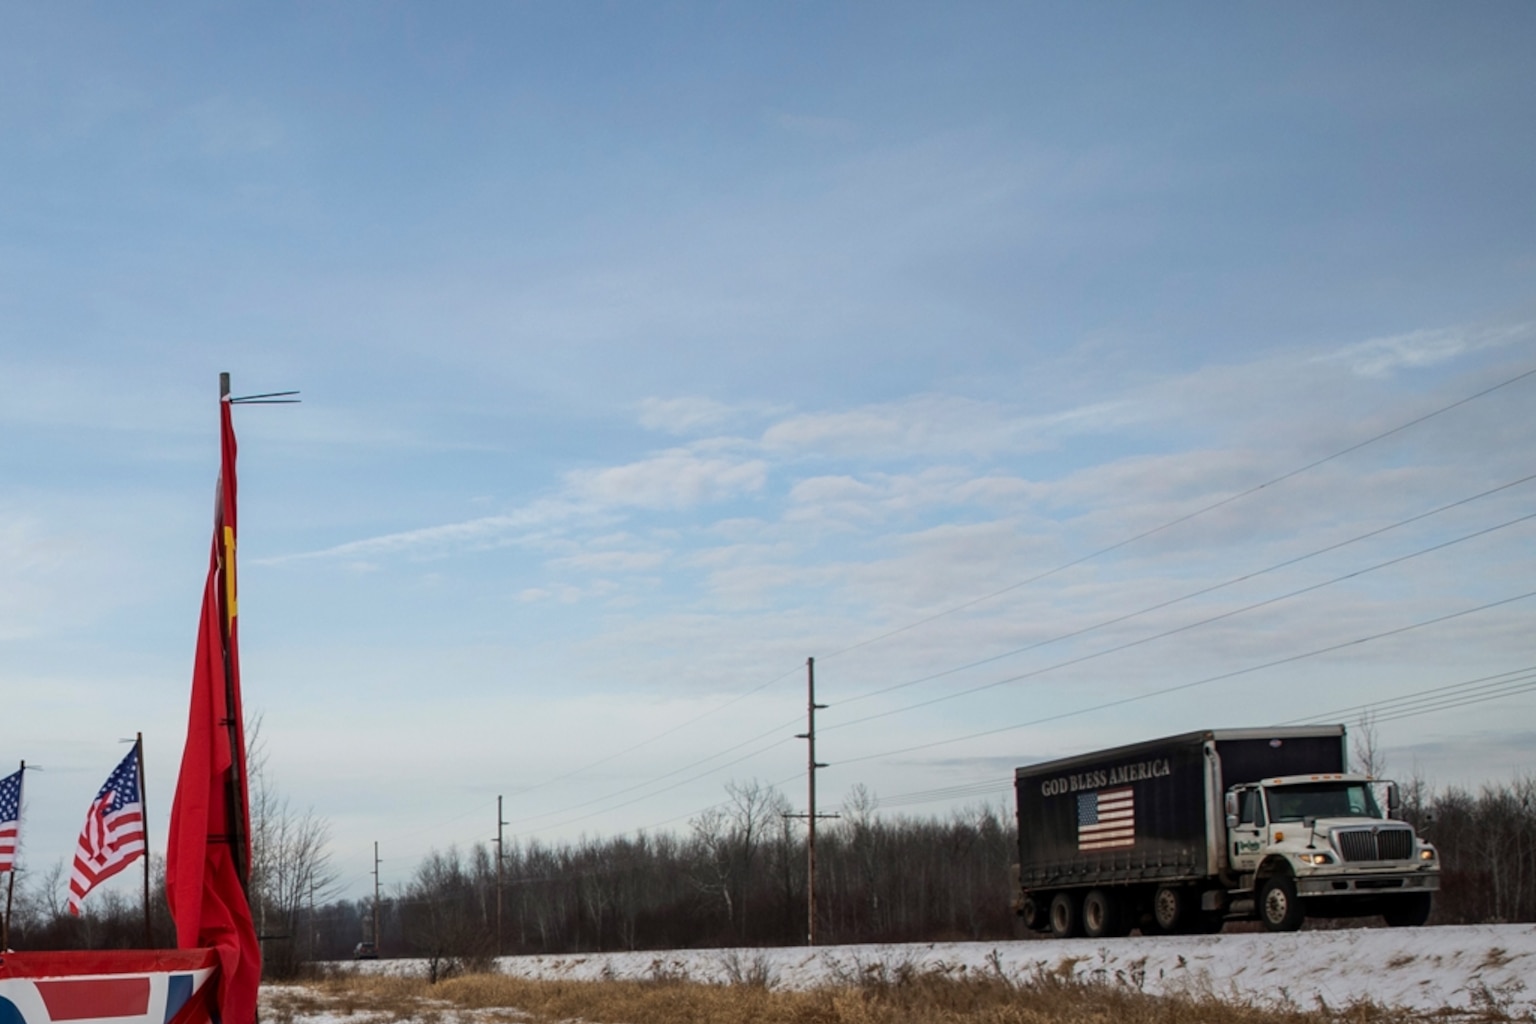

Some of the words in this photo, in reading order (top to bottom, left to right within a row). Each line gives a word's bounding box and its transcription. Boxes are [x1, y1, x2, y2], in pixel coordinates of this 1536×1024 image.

[1042, 778, 1068, 796] GOD
[1069, 770, 1107, 790] BLESS
[1109, 759, 1170, 785] AMERICA
